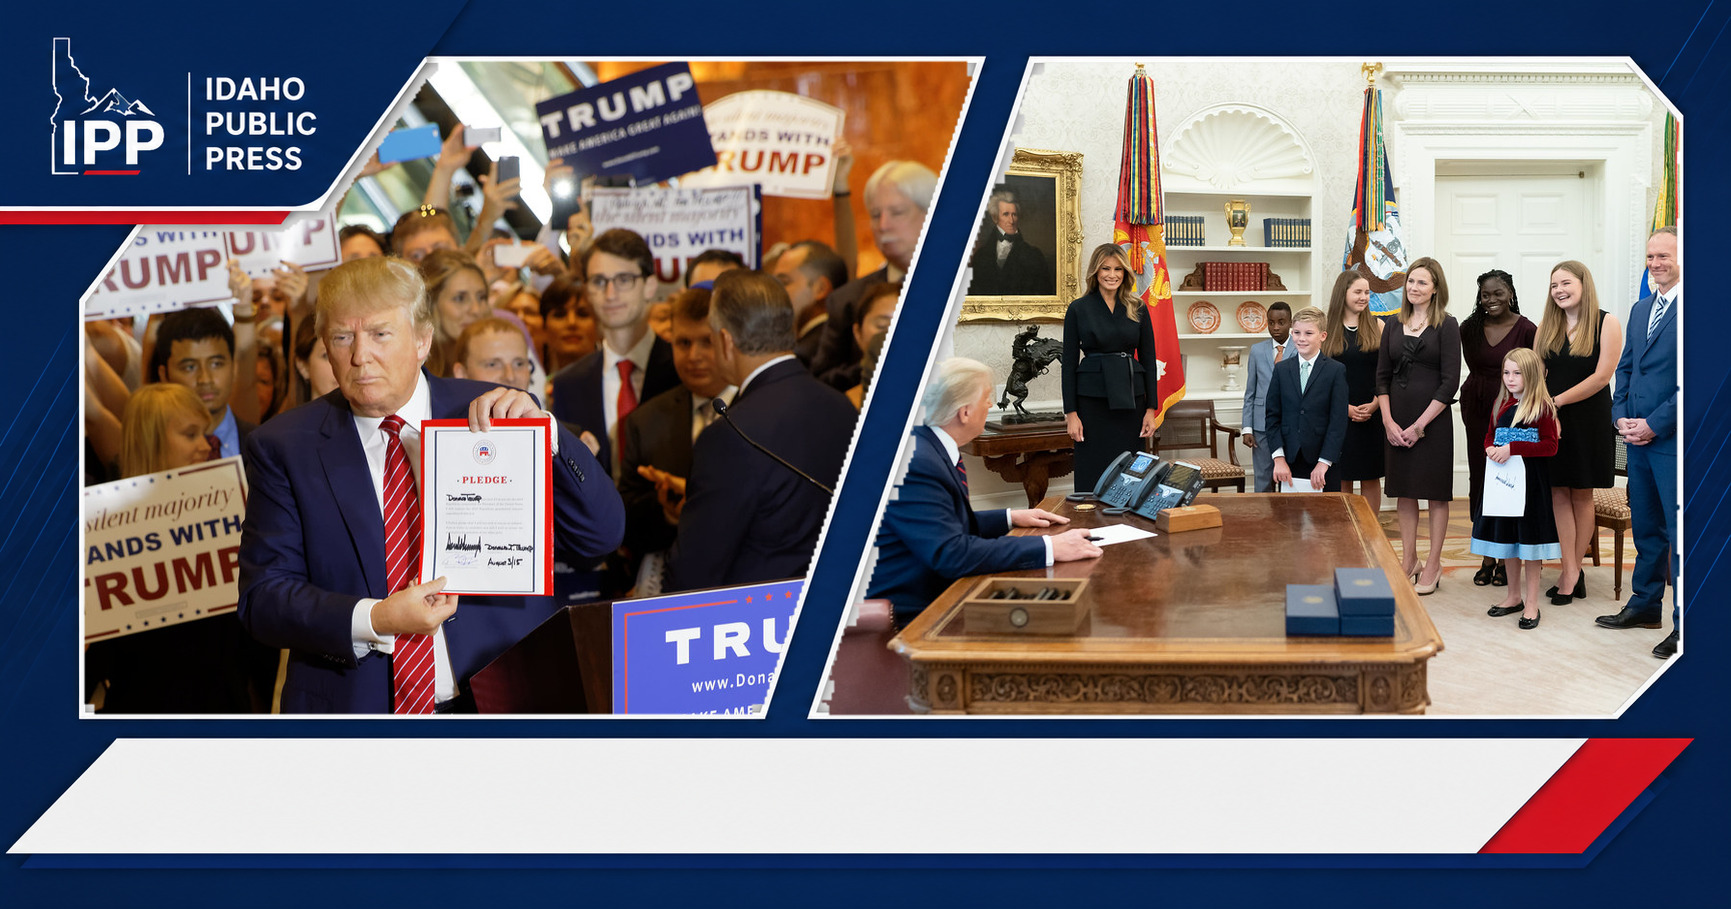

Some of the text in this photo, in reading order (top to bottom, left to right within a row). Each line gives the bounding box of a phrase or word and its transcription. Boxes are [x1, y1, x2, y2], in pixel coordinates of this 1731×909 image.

[540, 72, 694, 138] TRUMP
[777, 131, 830, 147] WITH
[688, 228, 744, 247] WITH
[462, 476, 508, 484] PLEDGE
[85, 486, 235, 534] silent majority
[169, 514, 242, 546] WITH
